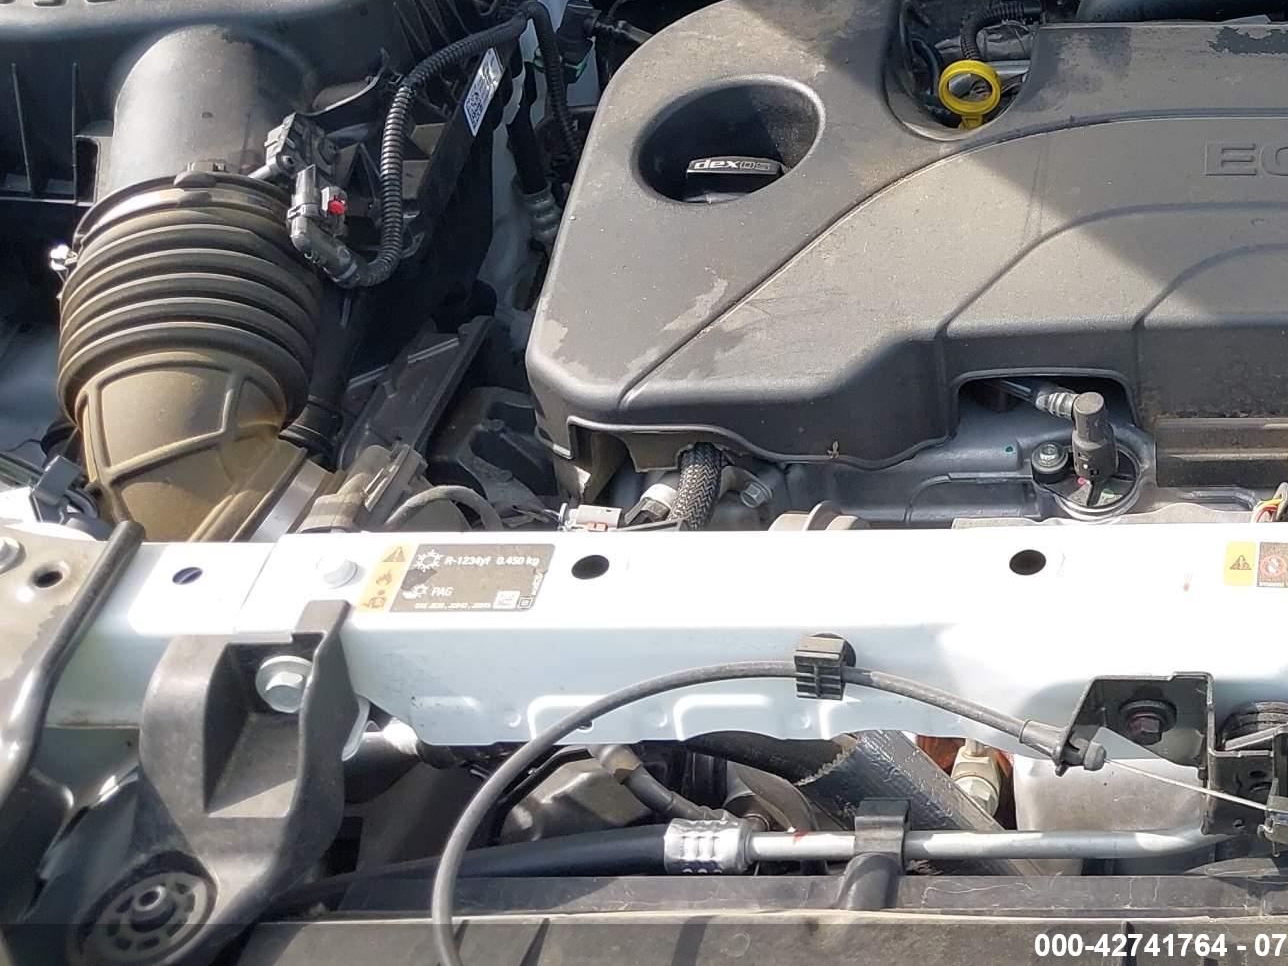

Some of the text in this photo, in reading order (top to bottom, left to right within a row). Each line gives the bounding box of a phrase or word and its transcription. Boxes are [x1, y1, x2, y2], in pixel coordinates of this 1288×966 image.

[693, 159, 770, 171] dexos
[444, 556, 540, 567] R-1234yf 0.450 kg
[431, 586, 454, 597] PAG
